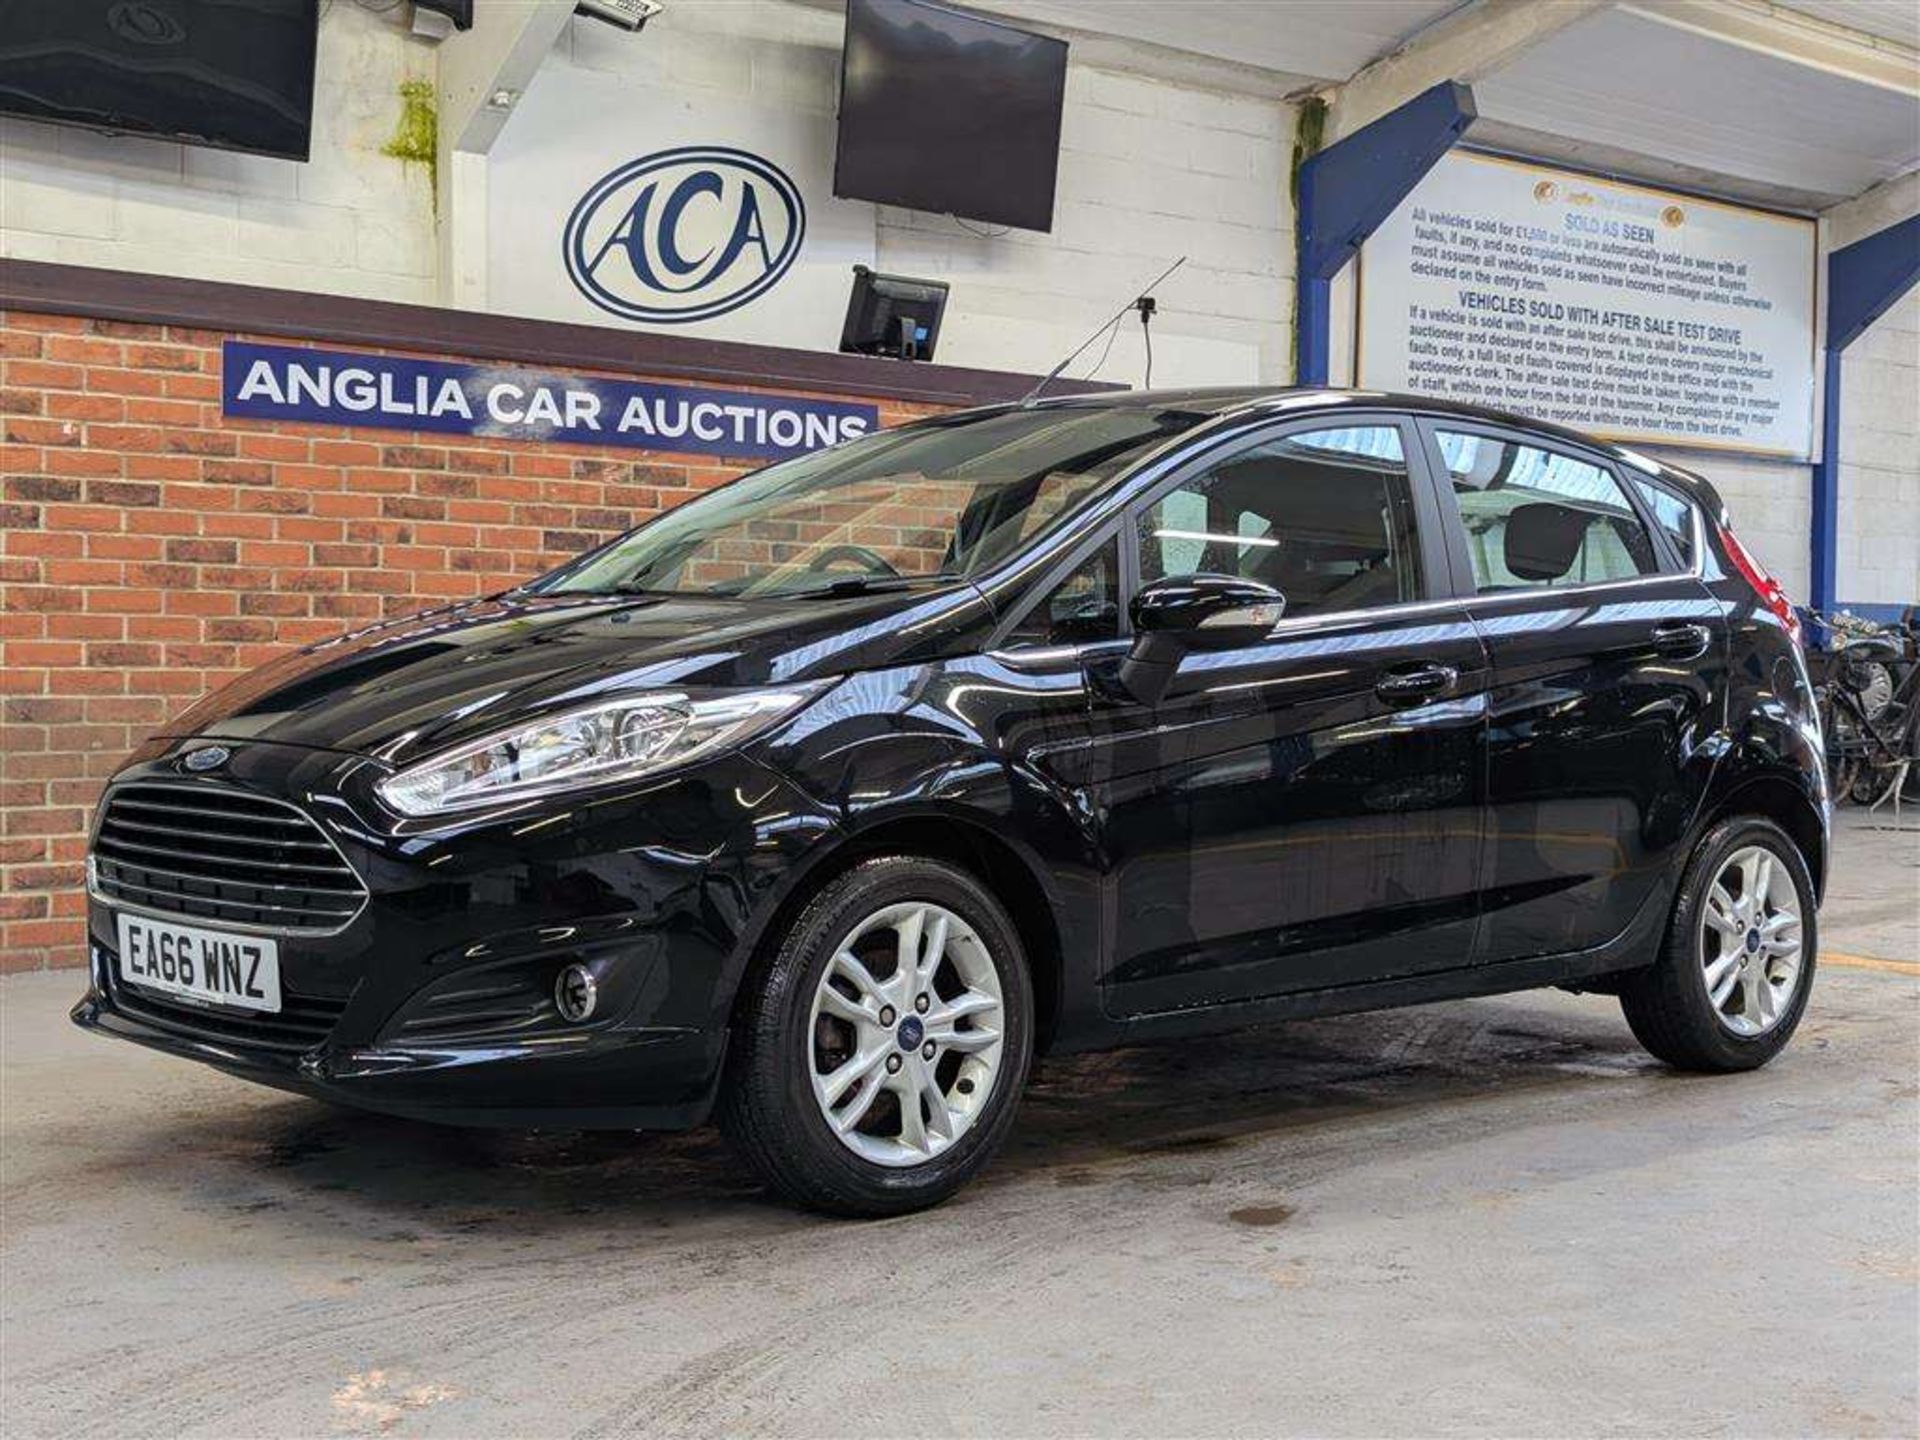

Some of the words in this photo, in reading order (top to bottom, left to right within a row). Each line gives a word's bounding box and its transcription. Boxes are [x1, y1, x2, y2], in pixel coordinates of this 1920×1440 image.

[586, 170, 774, 293] ACA
[1412, 206, 1426, 221] All
[1428, 211, 1472, 229] vehicles
[1474, 219, 1496, 233] sold
[1498, 222, 1514, 236] for
[1600, 241, 1660, 264] automatically
[1662, 252, 1680, 264] sold
[1682, 257, 1694, 266] as
[1716, 260, 1734, 273] with
[1736, 264, 1746, 275] all
[1414, 225, 1448, 244] faults,
[1450, 231, 1458, 244] if
[1482, 238, 1502, 251] and
[1504, 243, 1518, 254] no
[1574, 252, 1626, 271] whatsoever
[1628, 261, 1650, 275] shall
[1652, 264, 1662, 277] be
[1564, 213, 1600, 234] SOLD
[1602, 219, 1618, 237] AS
[1622, 223, 1654, 243] SEEN
[1410, 260, 1456, 278] declared
[1458, 270, 1472, 280] on
[1474, 270, 1490, 283] the
[1492, 274, 1520, 290] entry
[1410, 246, 1438, 258] must
[1440, 250, 1480, 265] assume
[1482, 255, 1494, 267] all
[1498, 258, 1538, 274] vehicles
[1540, 265, 1562, 277] sold
[1564, 270, 1576, 279] as
[1578, 272, 1600, 283] seen
[1600, 273, 1624, 287] have
[1624, 277, 1664, 293] incorrect
[1666, 284, 1700, 301] mileage
[1702, 291, 1730, 303] unless
[1732, 295, 1772, 310] otherwise
[1408, 304, 1418, 318] If
[1420, 309, 1426, 319] a
[1428, 308, 1466, 324] vehicle
[1468, 312, 1478, 325] is
[1478, 315, 1502, 328] sold
[1504, 318, 1526, 332] with
[1528, 323, 1540, 333] an
[1542, 323, 1564, 336] after
[1566, 327, 1586, 339] sale
[1588, 328, 1606, 342] test
[1634, 335, 1652, 348] this
[1654, 338, 1676, 351] shall
[1678, 340, 1688, 352] be
[1690, 345, 1736, 359] announced
[1738, 348, 1748, 363] by
[1750, 350, 1762, 362] the
[1458, 291, 1526, 315] VEHICLES
[1528, 300, 1564, 320] SOLD
[1566, 306, 1598, 325] WITH
[1602, 311, 1640, 331] AFTER
[1644, 317, 1674, 336] SALE
[1676, 321, 1704, 340] TEST
[1708, 326, 1740, 345] DRIVE
[1408, 325, 1464, 340] auctioneer
[1466, 332, 1488, 343] and
[1488, 333, 1532, 349] declared
[1534, 342, 1546, 351] on
[1548, 340, 1564, 353] the
[1566, 344, 1588, 359] entry
[1618, 349, 1624, 360] A
[1626, 350, 1644, 362] test
[1646, 353, 1668, 365] drive
[1702, 363, 1726, 374] major
[1408, 339, 1438, 355] faults
[1468, 349, 1474, 359] a
[1476, 348, 1494, 361] full
[1496, 350, 1510, 363] list
[1512, 353, 1524, 365] of
[1526, 354, 1552, 368] faults
[1556, 360, 1592, 372] covered
[1594, 362, 1602, 374] is
[1604, 363, 1650, 381] displayed
[1650, 369, 1660, 380] in
[1660, 370, 1676, 382] the
[1678, 373, 1702, 385] office
[1702, 377, 1720, 387] and
[1720, 378, 1738, 389] with
[1740, 380, 1754, 391] the
[237, 360, 473, 419] ANGLIA
[486, 383, 601, 430] CAR
[617, 396, 868, 449] AUCTIONS
[1408, 359, 1470, 376] auctioneer's
[1474, 366, 1502, 379] clerk.
[1504, 369, 1522, 381] The
[1526, 372, 1548, 384] after
[1550, 375, 1570, 387] sale
[1572, 376, 1590, 389] test
[1592, 379, 1614, 391] drive
[1616, 384, 1640, 394] must
[1642, 385, 1652, 396] be
[1722, 394, 1738, 405] with
[1408, 376, 1418, 387] of
[1422, 378, 1448, 392] staff,
[1450, 381, 1480, 394] within
[1484, 387, 1504, 396] one
[1504, 386, 1528, 399] hour
[1530, 389, 1552, 401] from
[1554, 392, 1570, 403] the
[1572, 393, 1586, 404] fall
[1588, 396, 1598, 406] of
[1600, 397, 1614, 407] the
[1658, 403, 1674, 416] Any
[1676, 407, 1722, 418] complaints
[1724, 410, 1734, 419] of
[1734, 414, 1748, 424] any
[1510, 404, 1534, 416] must
[1536, 405, 1548, 417] be
[1550, 409, 1590, 422] reported
[1592, 412, 1620, 424] within
[1622, 417, 1640, 426] one
[1640, 416, 1662, 428] hour
[1664, 419, 1684, 430] from
[1686, 421, 1700, 432] the
[1702, 423, 1718, 433] test
[129, 925, 194, 985] EA66
[202, 939, 264, 998] WNZ
